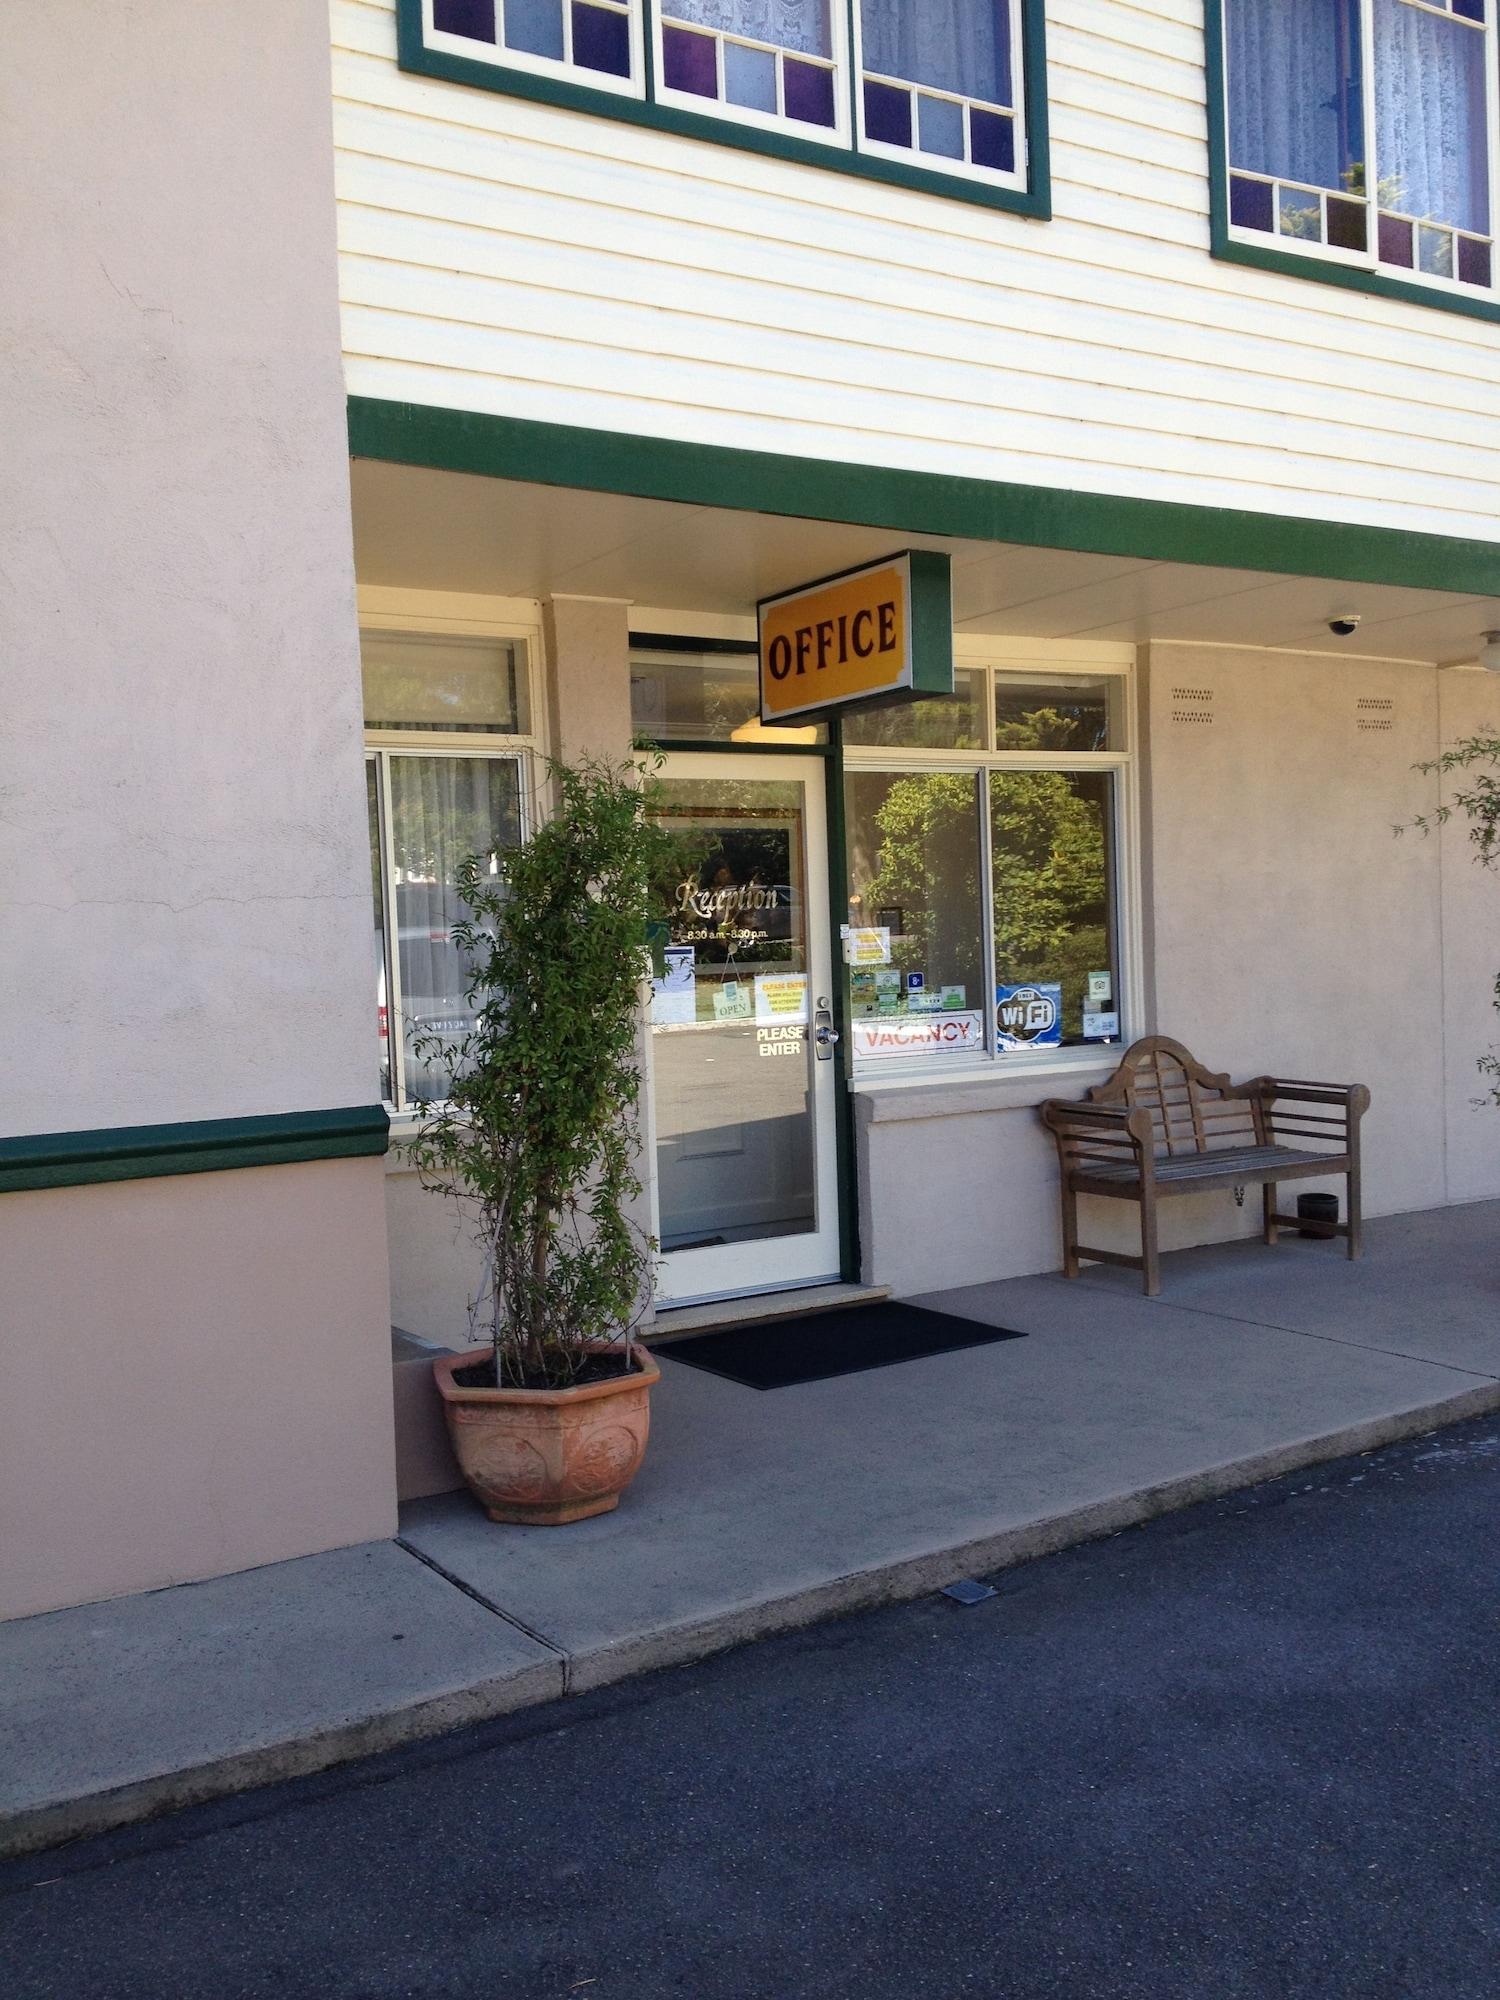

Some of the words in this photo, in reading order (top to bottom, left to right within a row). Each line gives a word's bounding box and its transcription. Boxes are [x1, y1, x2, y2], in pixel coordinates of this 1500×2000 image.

[769, 601, 897, 680] OFFICE
[676, 873, 778, 925] Reception
[687, 930, 707, 940] 8.30
[731, 929, 750, 939] 8.30
[719, 1003, 746, 1016] OPEN
[757, 1026, 804, 1041] PLEASE
[866, 1022, 970, 1047] VACANCY
[760, 1042, 800, 1056] ENTER
